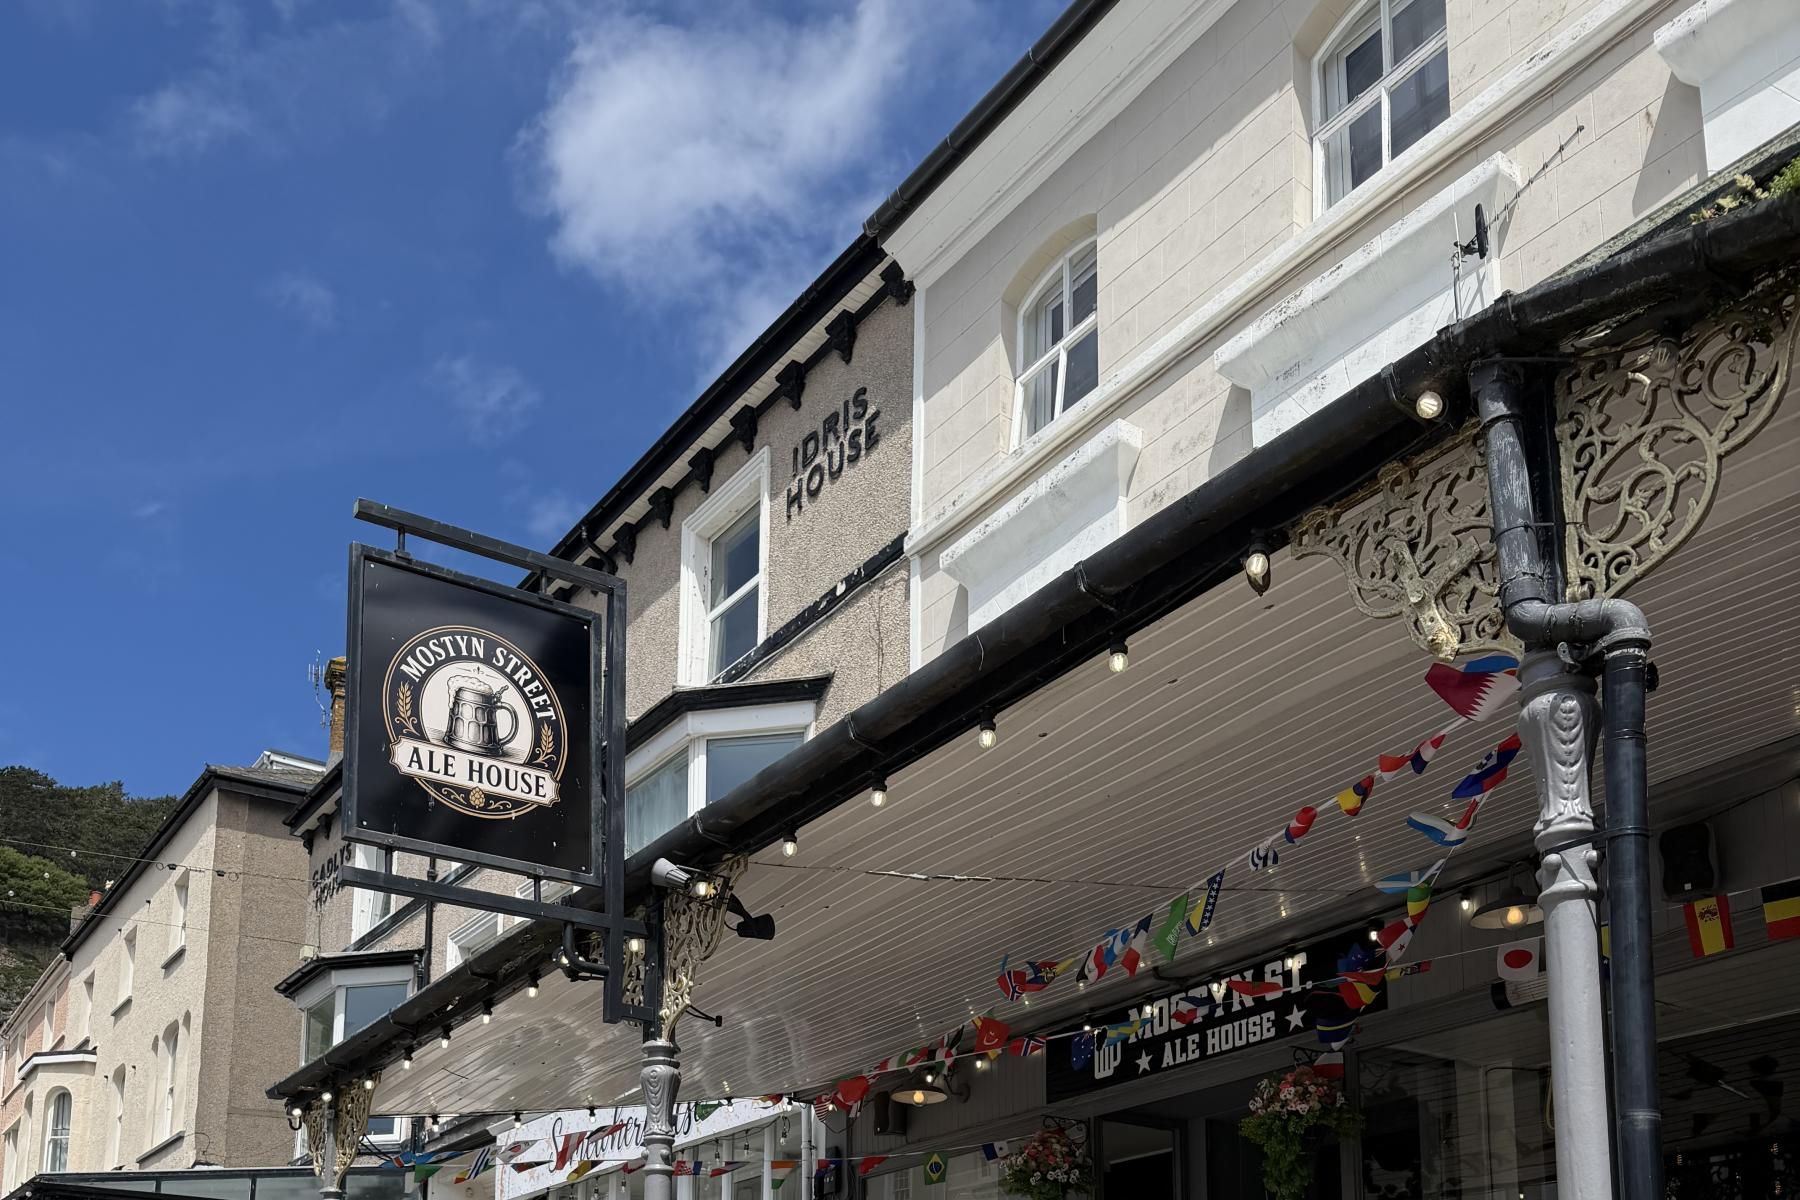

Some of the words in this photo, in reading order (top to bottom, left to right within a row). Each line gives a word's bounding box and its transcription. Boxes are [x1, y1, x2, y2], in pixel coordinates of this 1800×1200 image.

[786, 409, 881, 519] HOUSE
[792, 386, 868, 477] IDRIS
[400, 635, 485, 683] MOSTYN
[493, 647, 557, 721] STREET
[407, 746, 456, 779] ALE
[467, 757, 547, 799] HOUSE
[1264, 951, 1313, 1001] ST.
[1161, 1033, 1201, 1069] ALE
[1206, 1010, 1276, 1056] HOUSE
